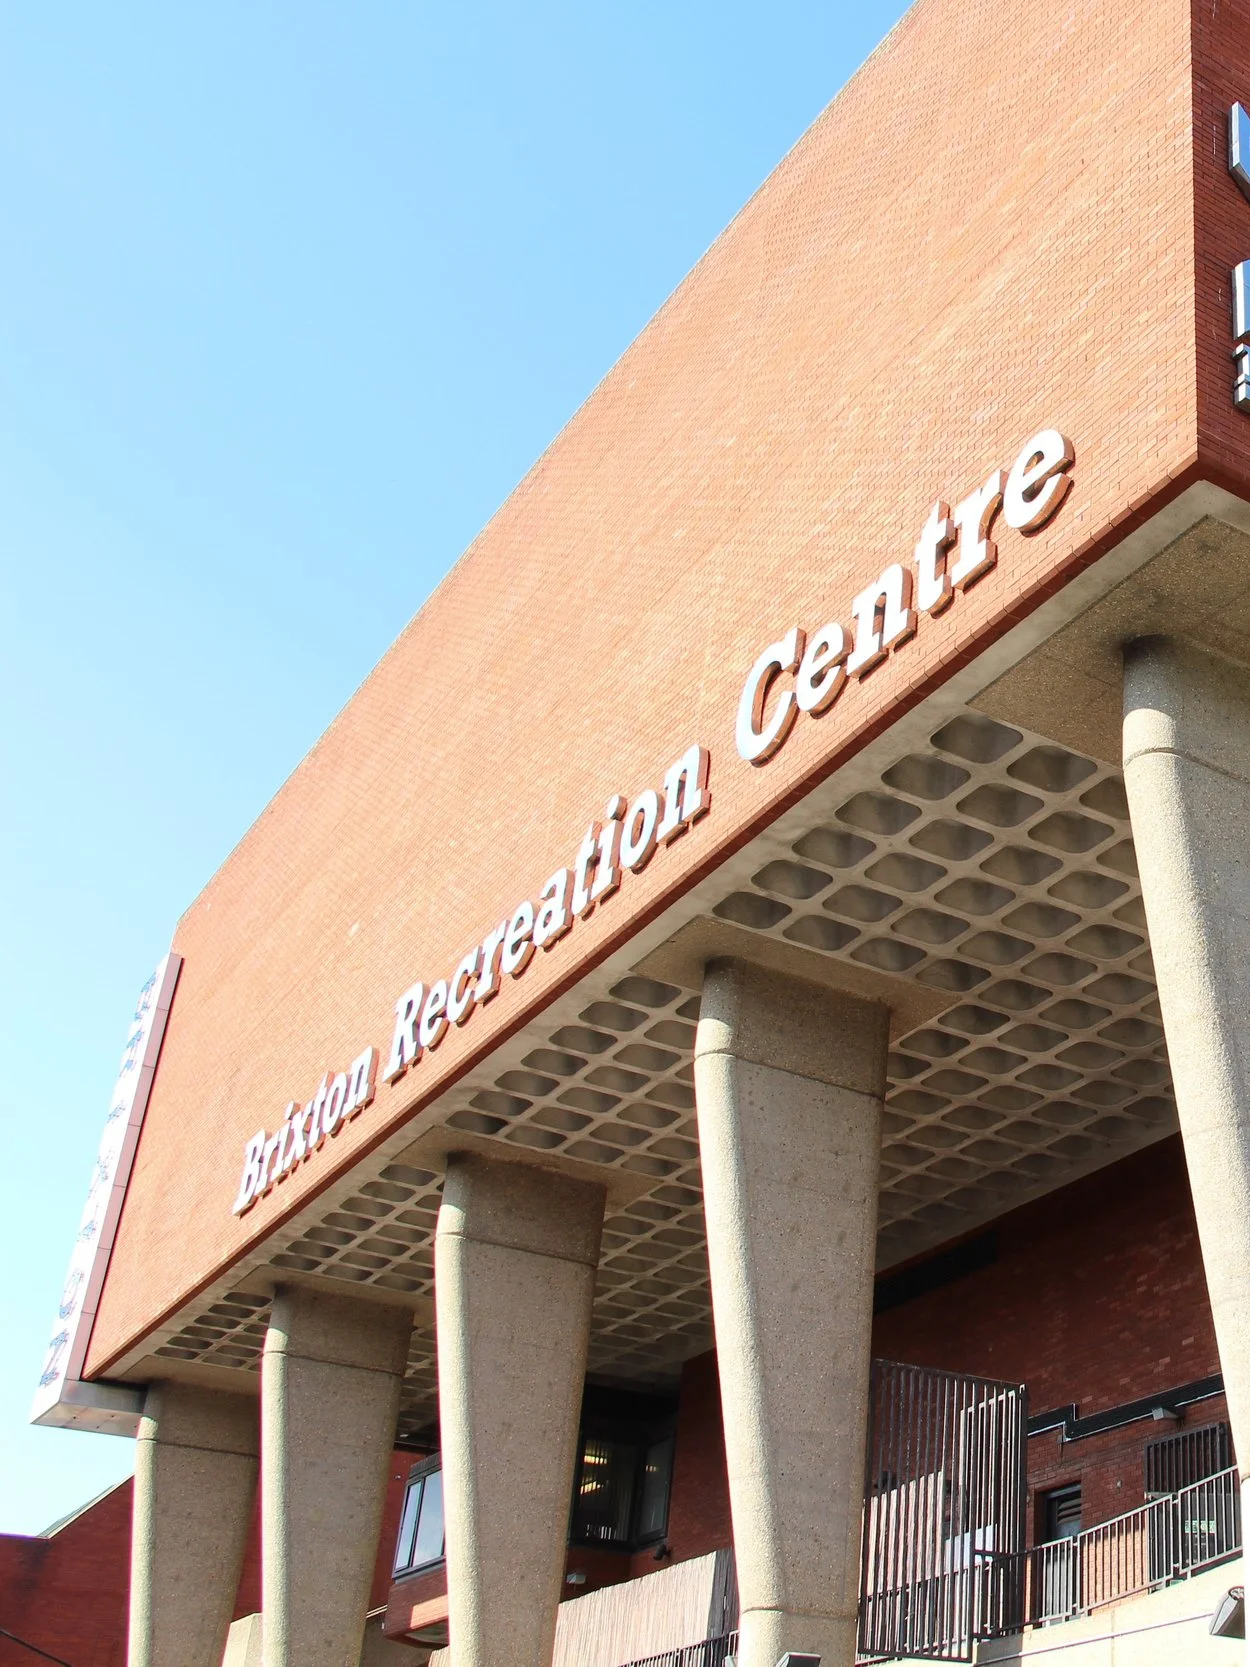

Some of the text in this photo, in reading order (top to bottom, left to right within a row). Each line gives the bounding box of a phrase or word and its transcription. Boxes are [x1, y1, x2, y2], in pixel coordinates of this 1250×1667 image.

[233, 427, 1076, 1217] Brixton Recreation Centre
